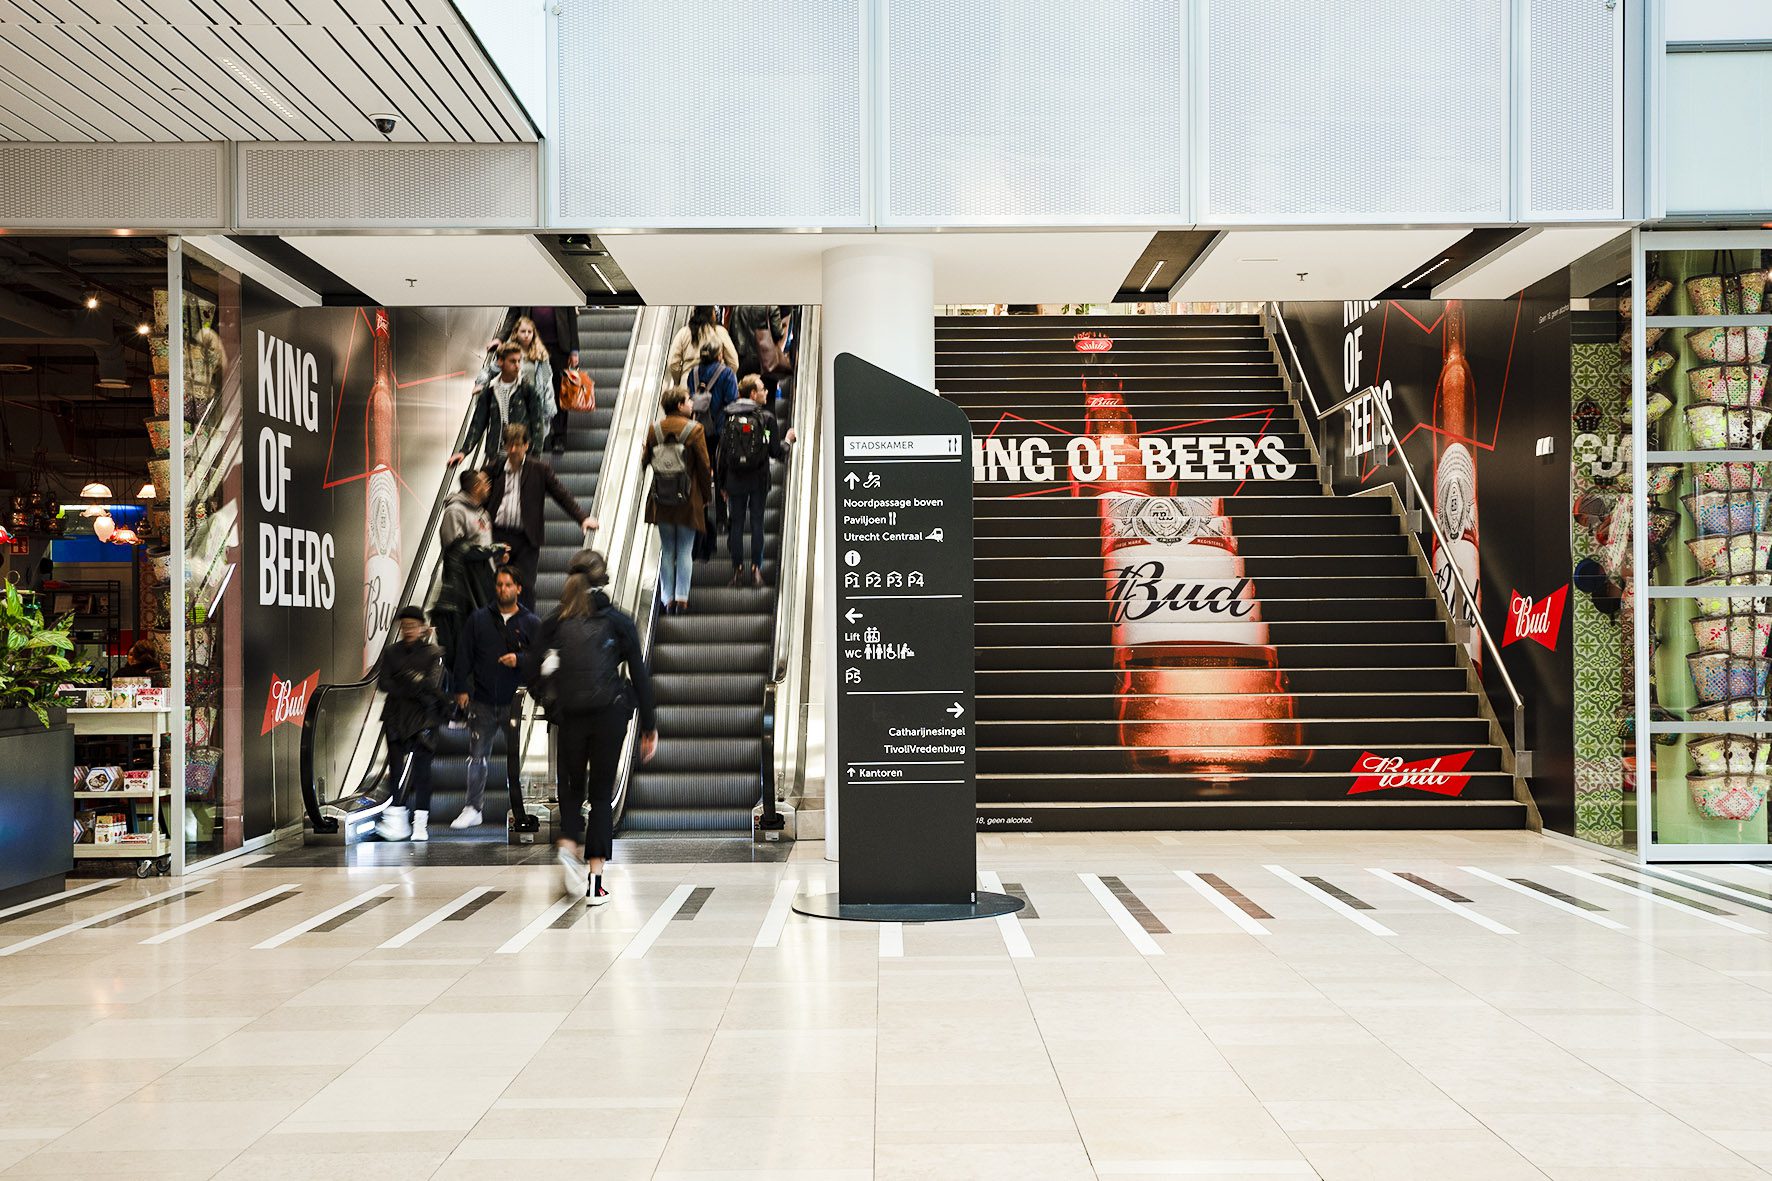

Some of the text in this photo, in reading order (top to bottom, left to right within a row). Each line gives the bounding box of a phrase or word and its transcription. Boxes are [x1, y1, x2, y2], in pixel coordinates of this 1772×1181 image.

[1344, 325, 1362, 393] OF
[257, 329, 318, 433] KING
[849, 441, 914, 450] STADSKAMER
[973, 435, 1297, 481] ING OF BEERS
[258, 426, 292, 514] OF
[843, 498, 944, 509] Noordpassage boven
[843, 516, 887, 526] Paviljoen
[843, 532, 923, 541] Utrecht Centraal
[259, 522, 336, 610] BEERS
[844, 574, 924, 588] P1 P2 P3 P4
[1103, 561, 1255, 627] Bud
[364, 576, 398, 648] Bu
[1512, 596, 1552, 638] Bud
[844, 632, 861, 642] Lift
[844, 649, 863, 659] WC
[845, 670, 862, 684] P5
[272, 679, 307, 723] Bud
[888, 727, 966, 738] Catharijnesingel
[884, 744, 966, 755] TivoliVredenburg
[859, 768, 903, 778] Kantoren
[1362, 756, 1450, 788] Bud
